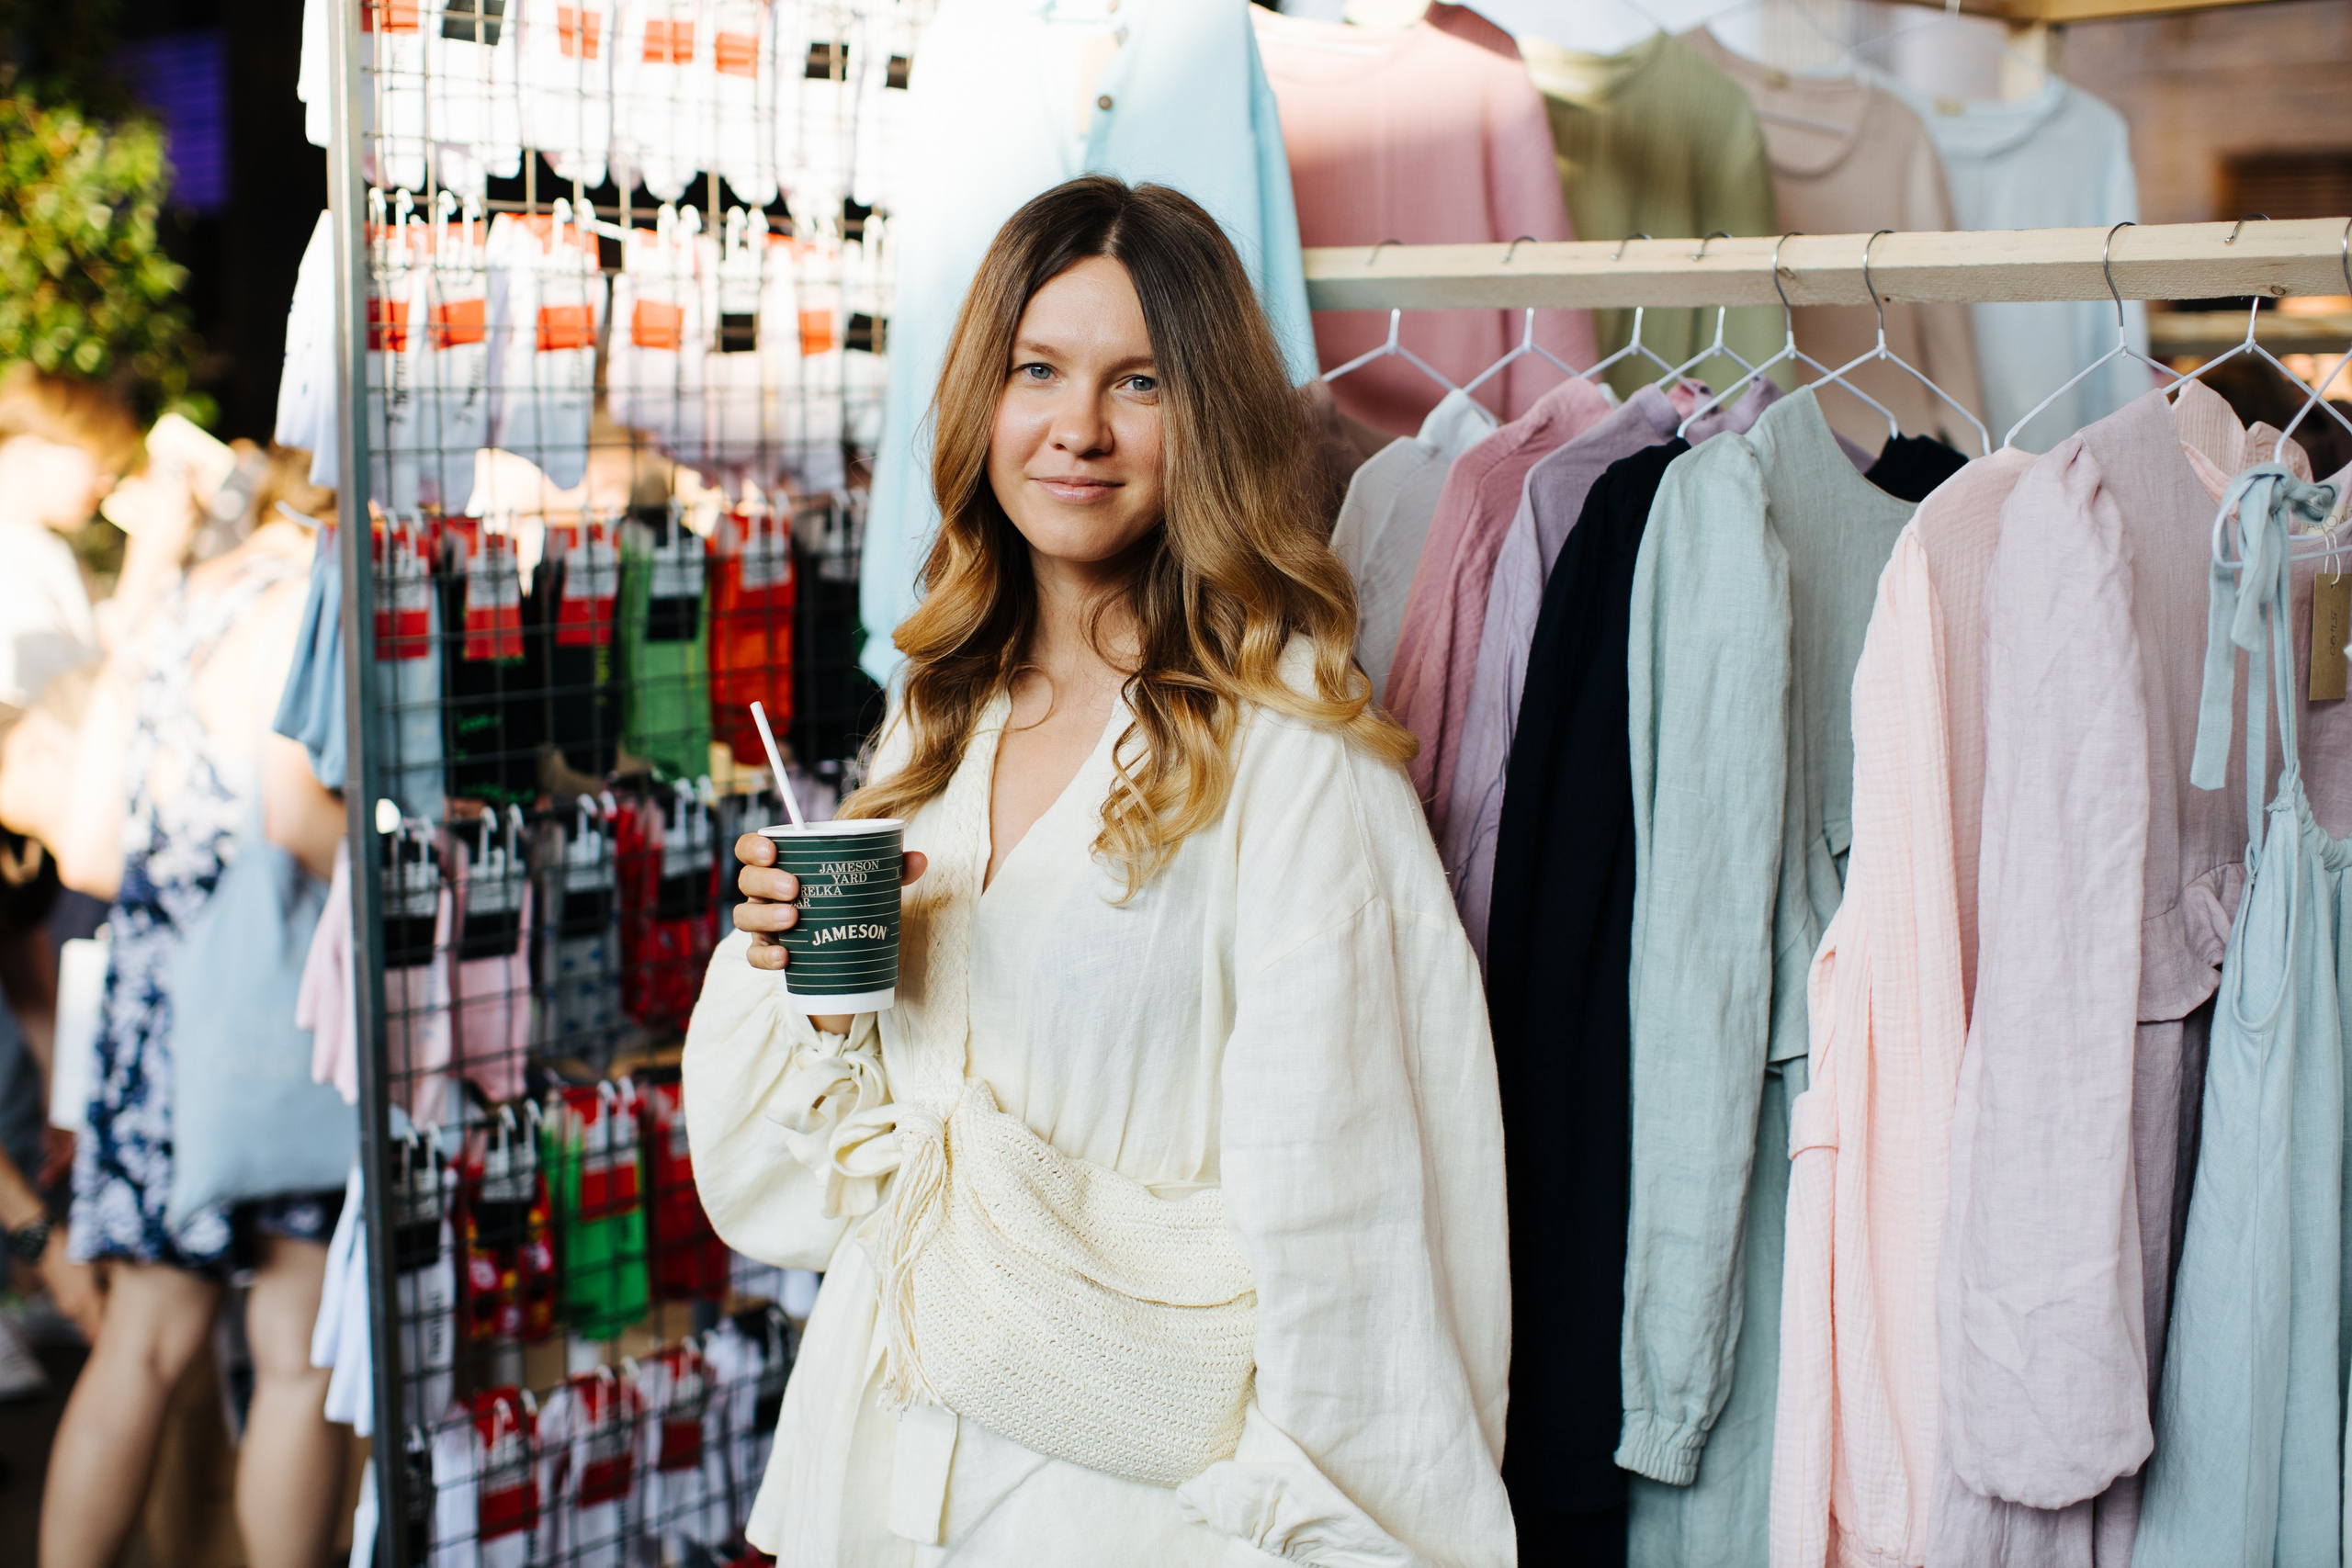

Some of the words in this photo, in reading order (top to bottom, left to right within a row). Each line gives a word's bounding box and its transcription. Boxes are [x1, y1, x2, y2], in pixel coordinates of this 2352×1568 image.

[819, 860, 879, 874] JAMESON
[831, 873, 867, 885] YARD
[812, 924, 888, 946] JAMESON
